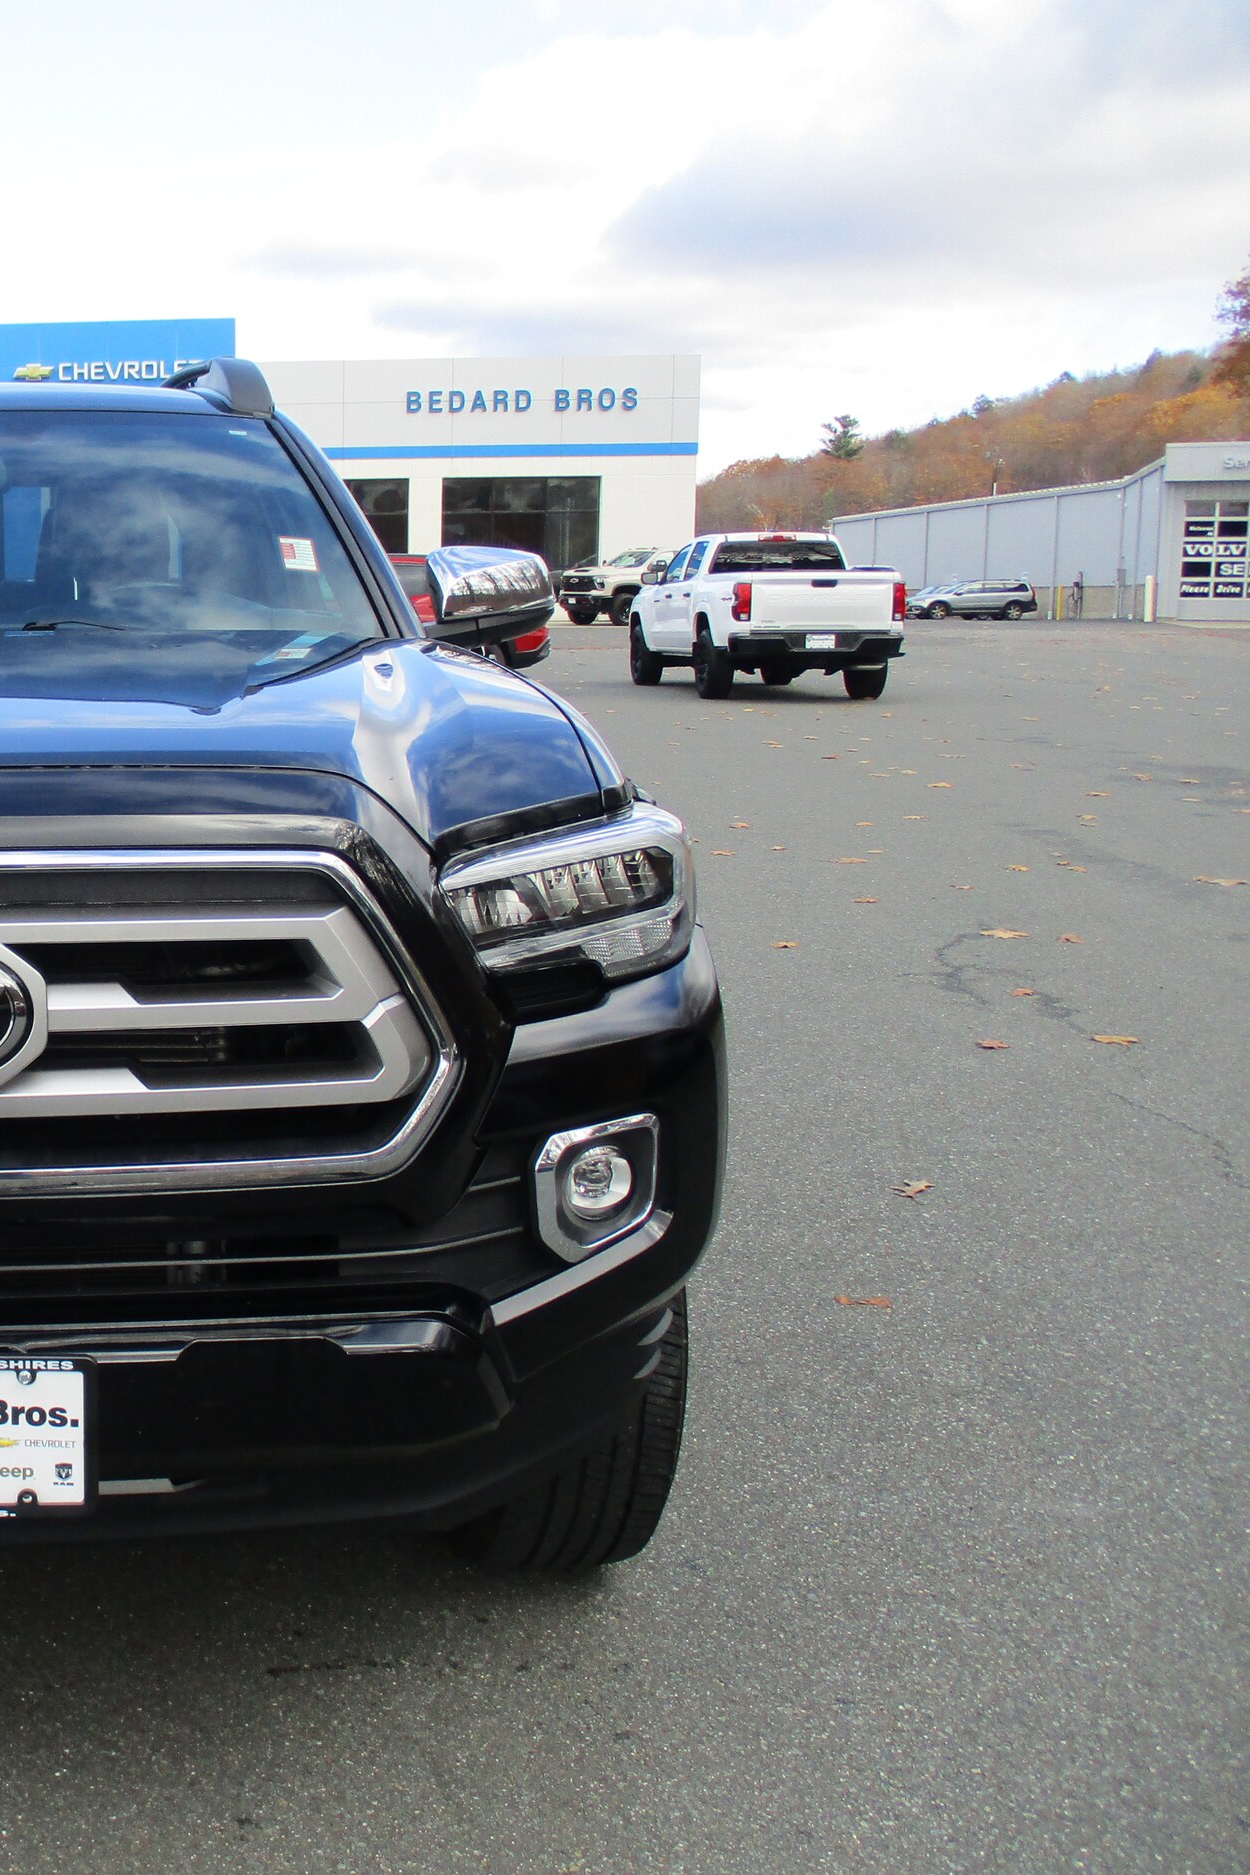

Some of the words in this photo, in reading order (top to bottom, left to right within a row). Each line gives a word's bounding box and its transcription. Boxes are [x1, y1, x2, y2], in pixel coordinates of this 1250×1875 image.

[406, 390, 532, 414] BEDARD
[554, 387, 639, 411] BROS
[1181, 584, 1210, 593] Please
[1216, 584, 1241, 593] Drive
[24, 1438, 76, 1449] CHEVROLET
